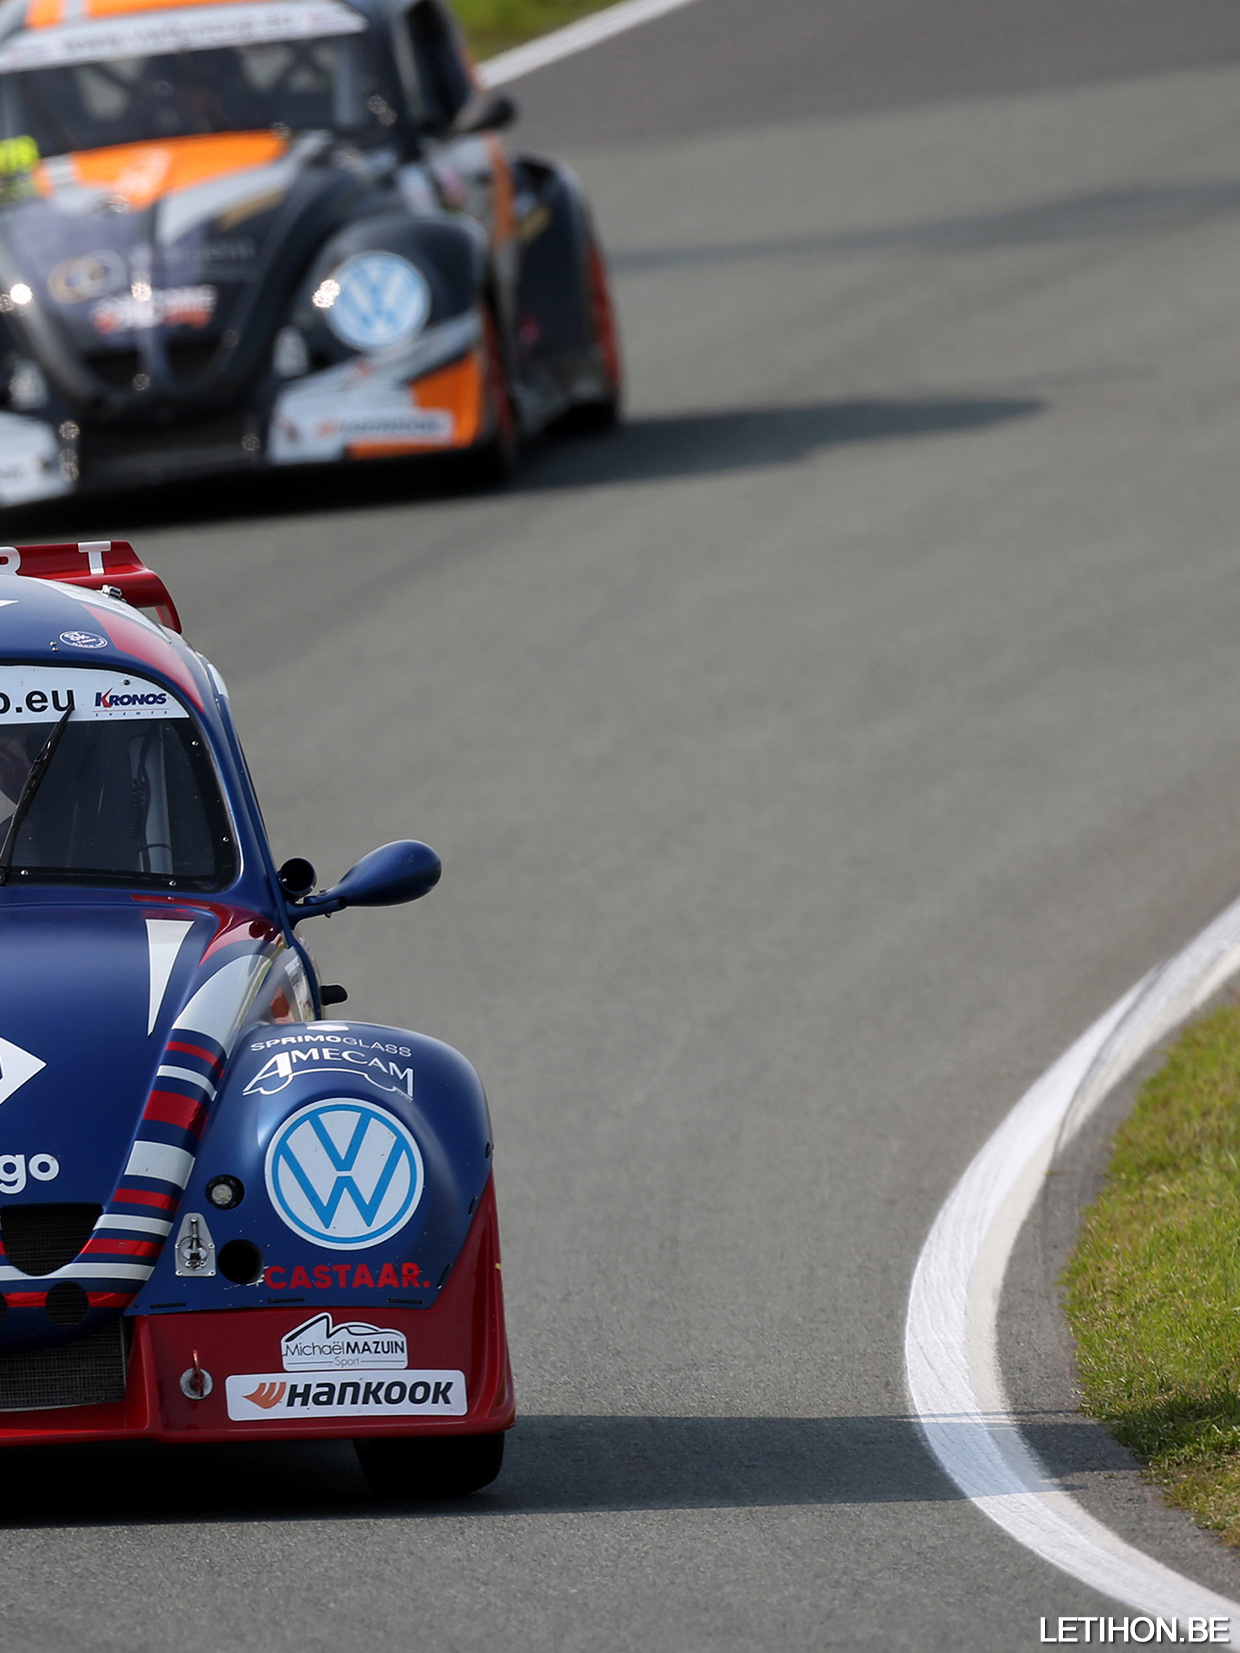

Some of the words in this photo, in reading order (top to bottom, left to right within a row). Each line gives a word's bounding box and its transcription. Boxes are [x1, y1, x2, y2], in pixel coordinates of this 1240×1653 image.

[94, 688, 167, 708] KRONOS
[250, 1034, 412, 1058] SPRIMOGLASS
[243, 1047, 414, 1098] AMECAM
[272, 1103, 417, 1244] VW
[264, 1262, 431, 1290] CASTAAR.
[334, 1356, 360, 1368] Sport
